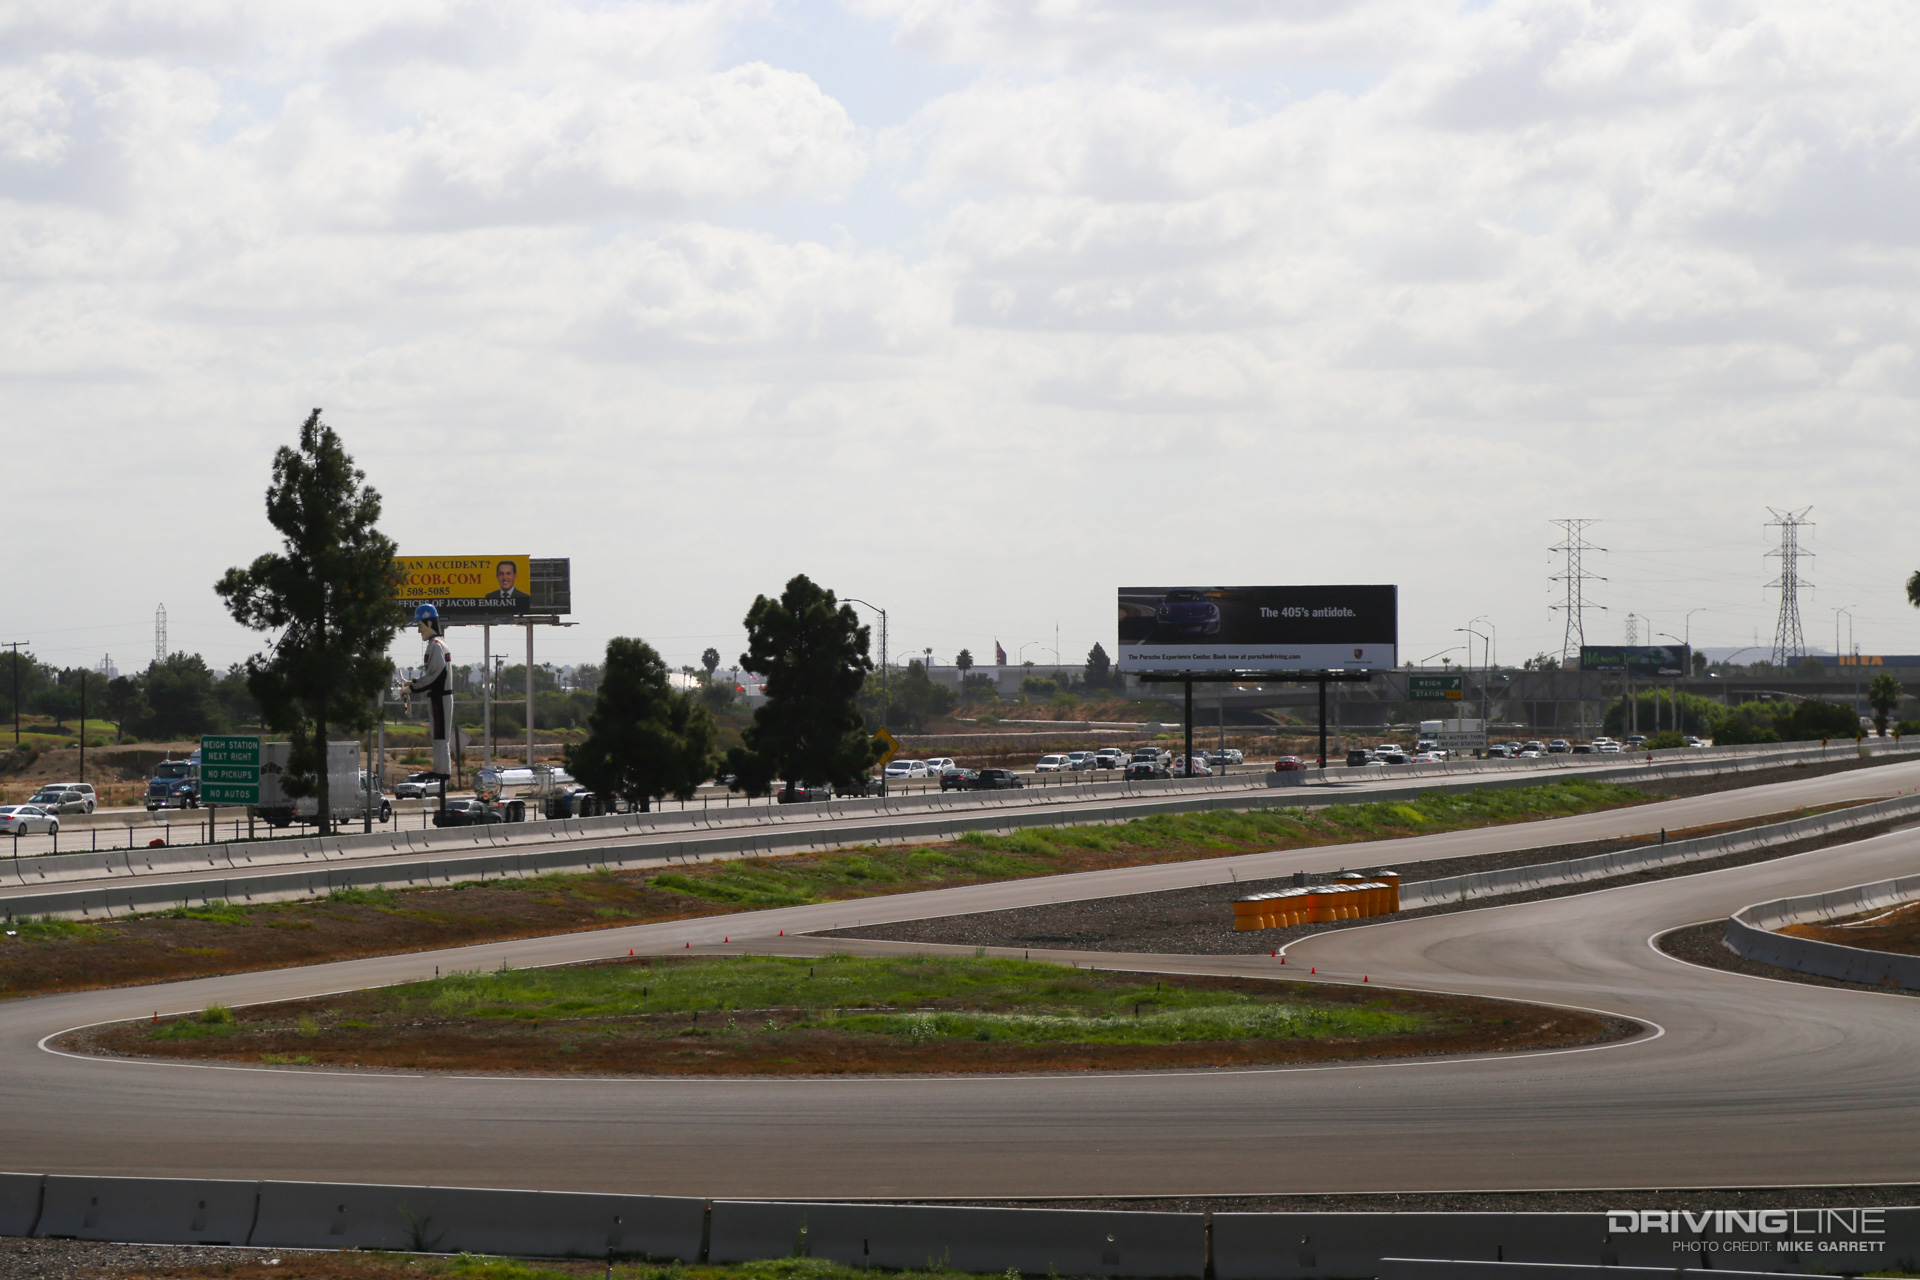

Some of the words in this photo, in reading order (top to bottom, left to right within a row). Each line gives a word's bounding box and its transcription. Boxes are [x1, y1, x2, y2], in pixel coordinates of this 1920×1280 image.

[408, 561, 423, 570] AN
[427, 560, 491, 570] ACCIDENT?
[407, 587, 450, 596] 508-5085
[432, 599, 445, 608] OF
[446, 599, 476, 607] JACOB
[478, 598, 516, 607] EMRANI
[1260, 607, 1279, 618] The
[1281, 607, 1310, 618] 405's
[1312, 607, 1356, 618] antidote.
[1247, 653, 1301, 661] porschedriving.com
[1838, 655, 1884, 666] IKEA
[203, 740, 225, 749] WEIGH
[229, 741, 258, 750] STATION
[208, 752, 227, 760] NEXT
[231, 752, 252, 761] RIGHT
[208, 770, 218, 778] NO
[221, 770, 252, 779] PICKUPS
[210, 789, 221, 798] NO
[224, 790, 250, 799] AUTOS
